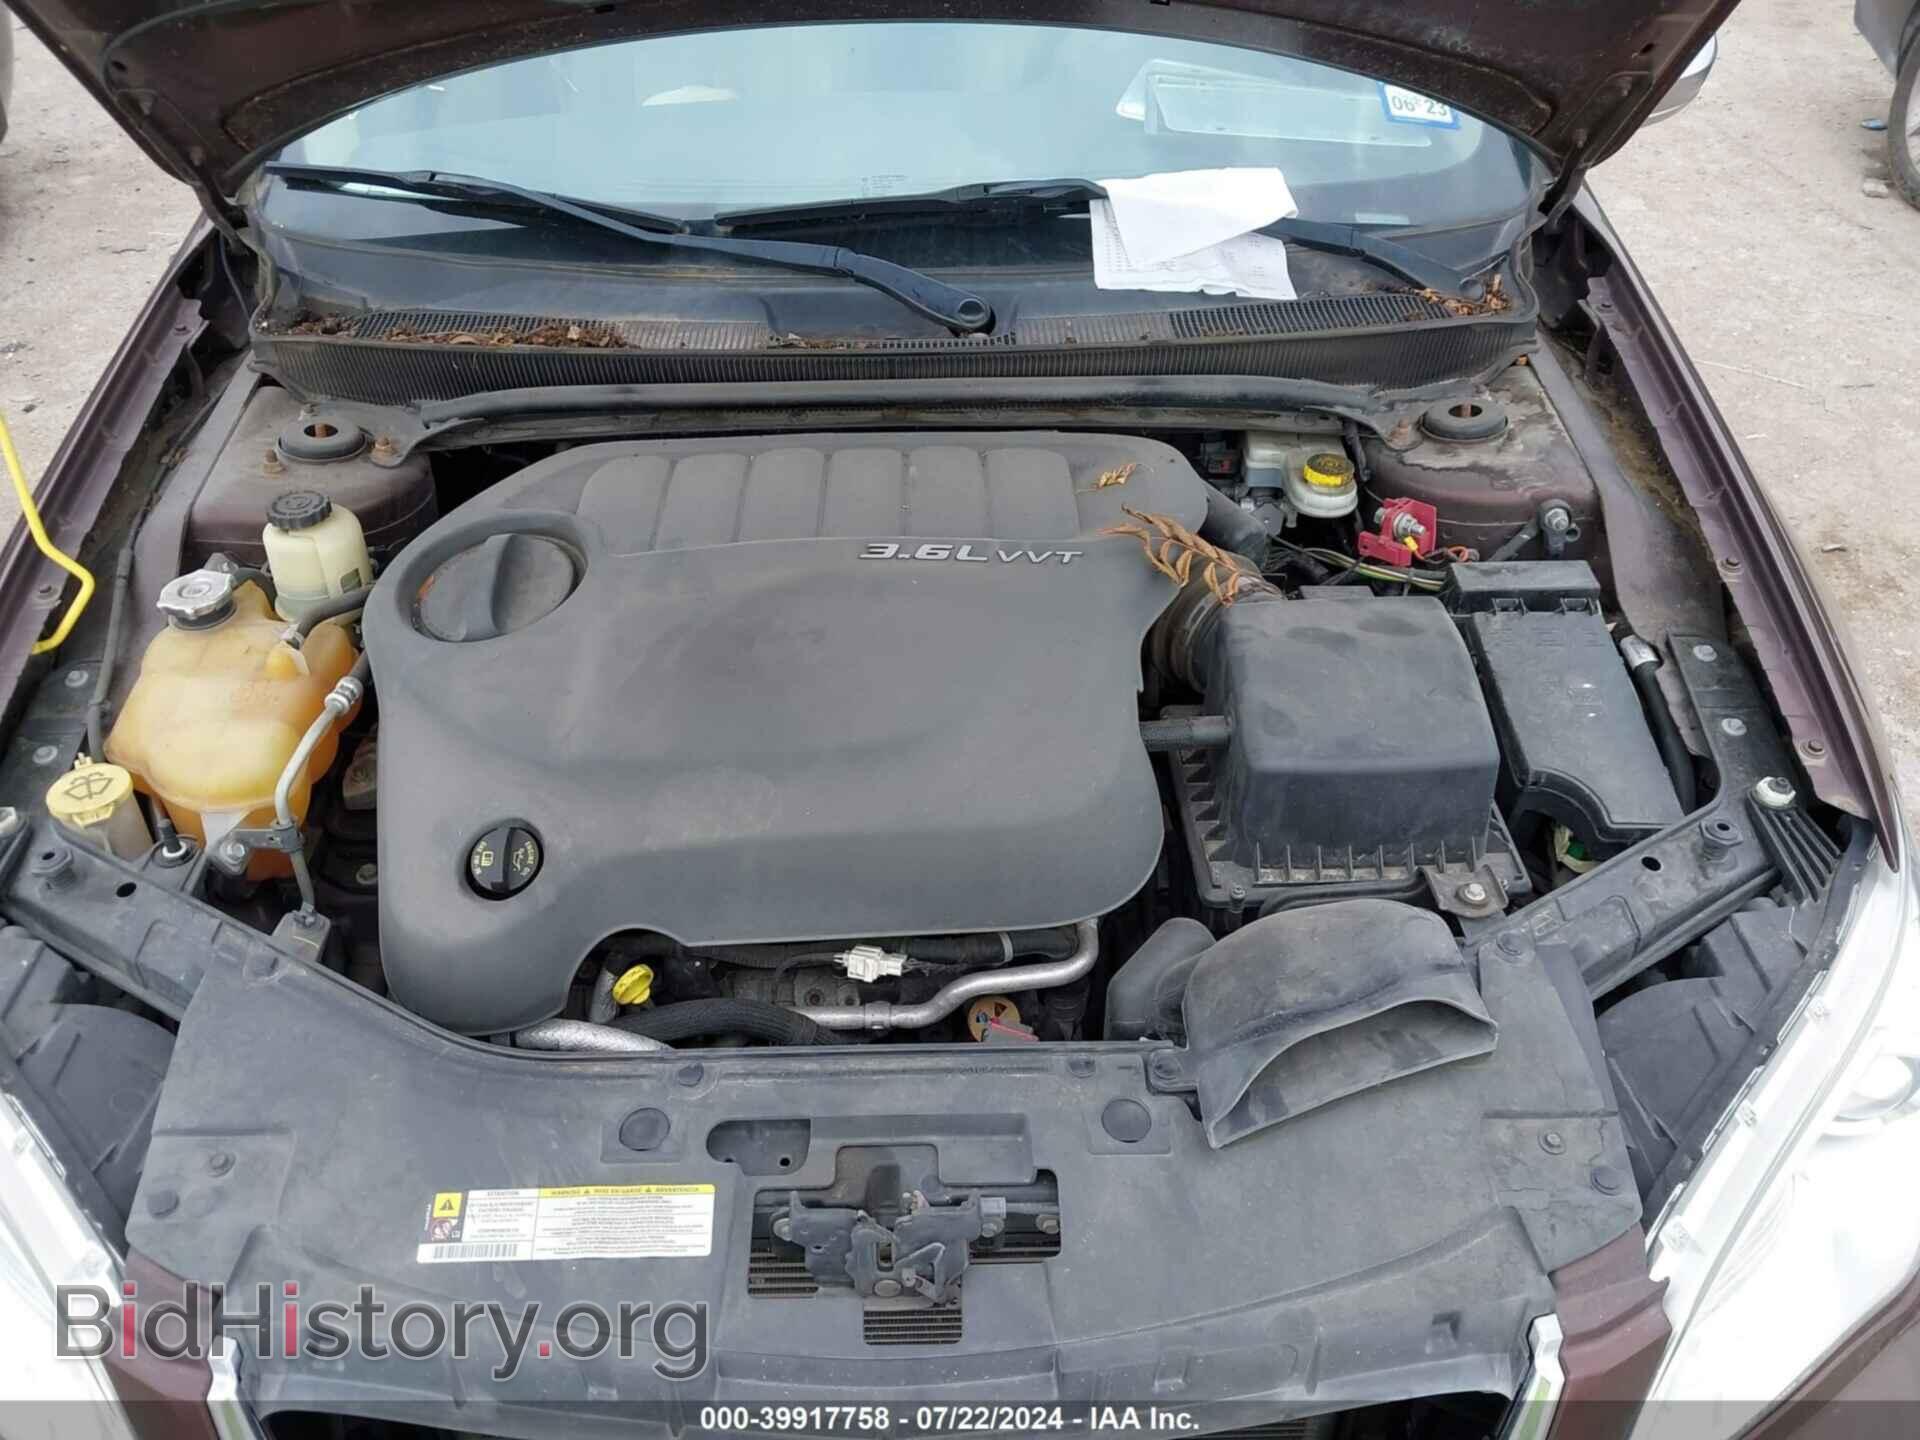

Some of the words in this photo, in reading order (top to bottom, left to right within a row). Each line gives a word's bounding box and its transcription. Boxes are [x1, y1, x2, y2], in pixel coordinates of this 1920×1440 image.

[1391, 95, 1416, 113] 06
[1423, 99, 1448, 117] 23
[858, 543, 988, 562] 3.6L
[996, 549, 1083, 564] VVT
